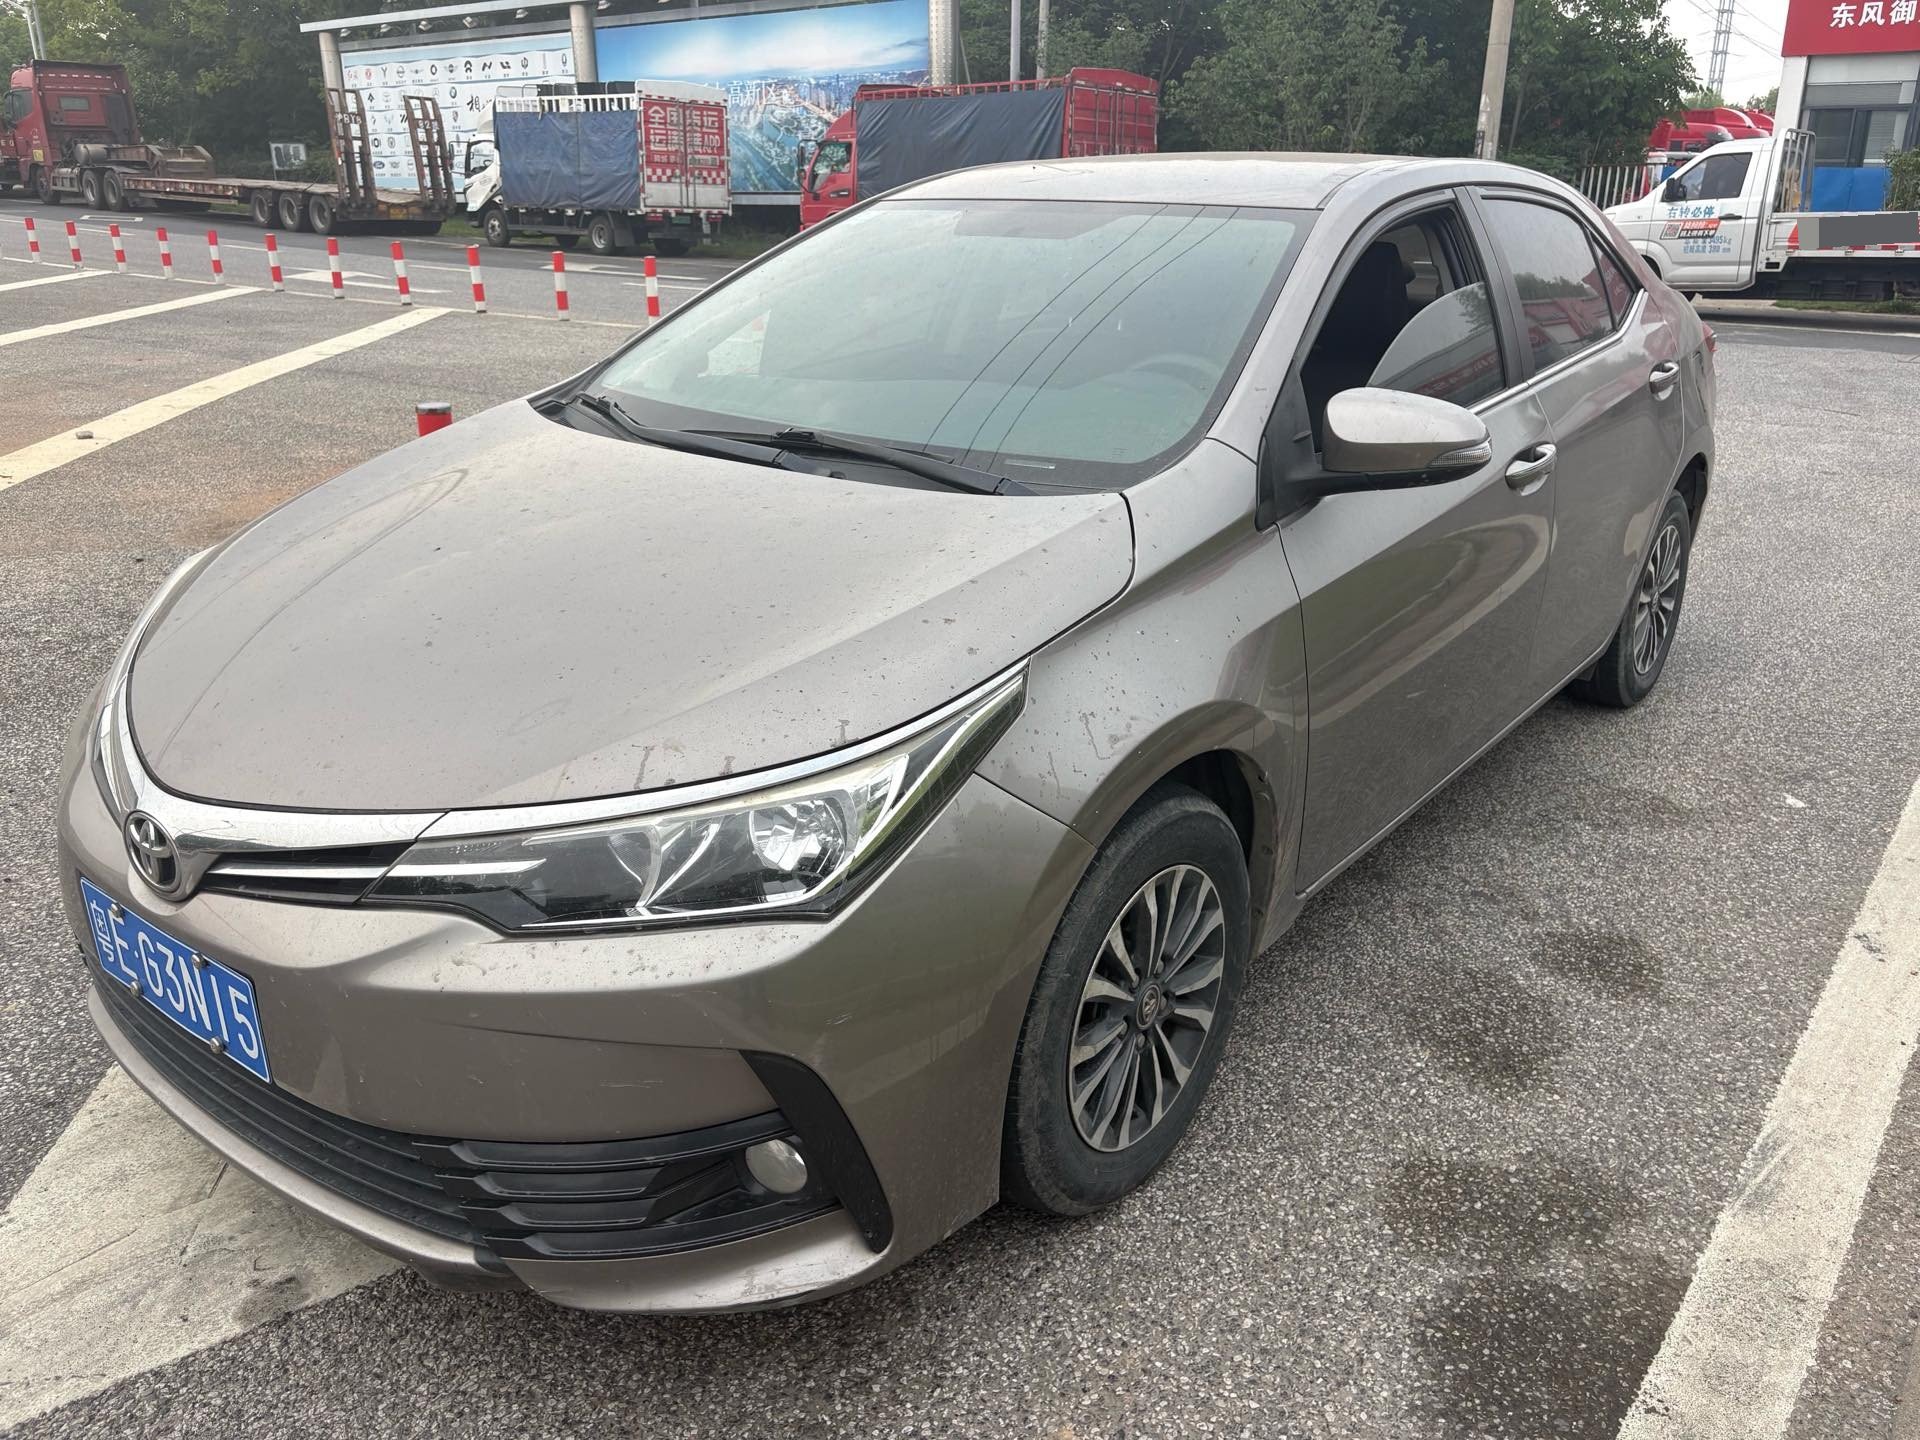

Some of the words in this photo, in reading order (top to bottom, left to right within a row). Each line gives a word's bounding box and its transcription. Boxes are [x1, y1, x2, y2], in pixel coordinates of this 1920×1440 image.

[1830, 0, 1920, 28] 东风御
[704, 79, 779, 107] 高新区
[647, 106, 719, 133] 全国货运
[650, 129, 721, 153] 运满满APP
[1667, 206, 1715, 218] 右转必停
